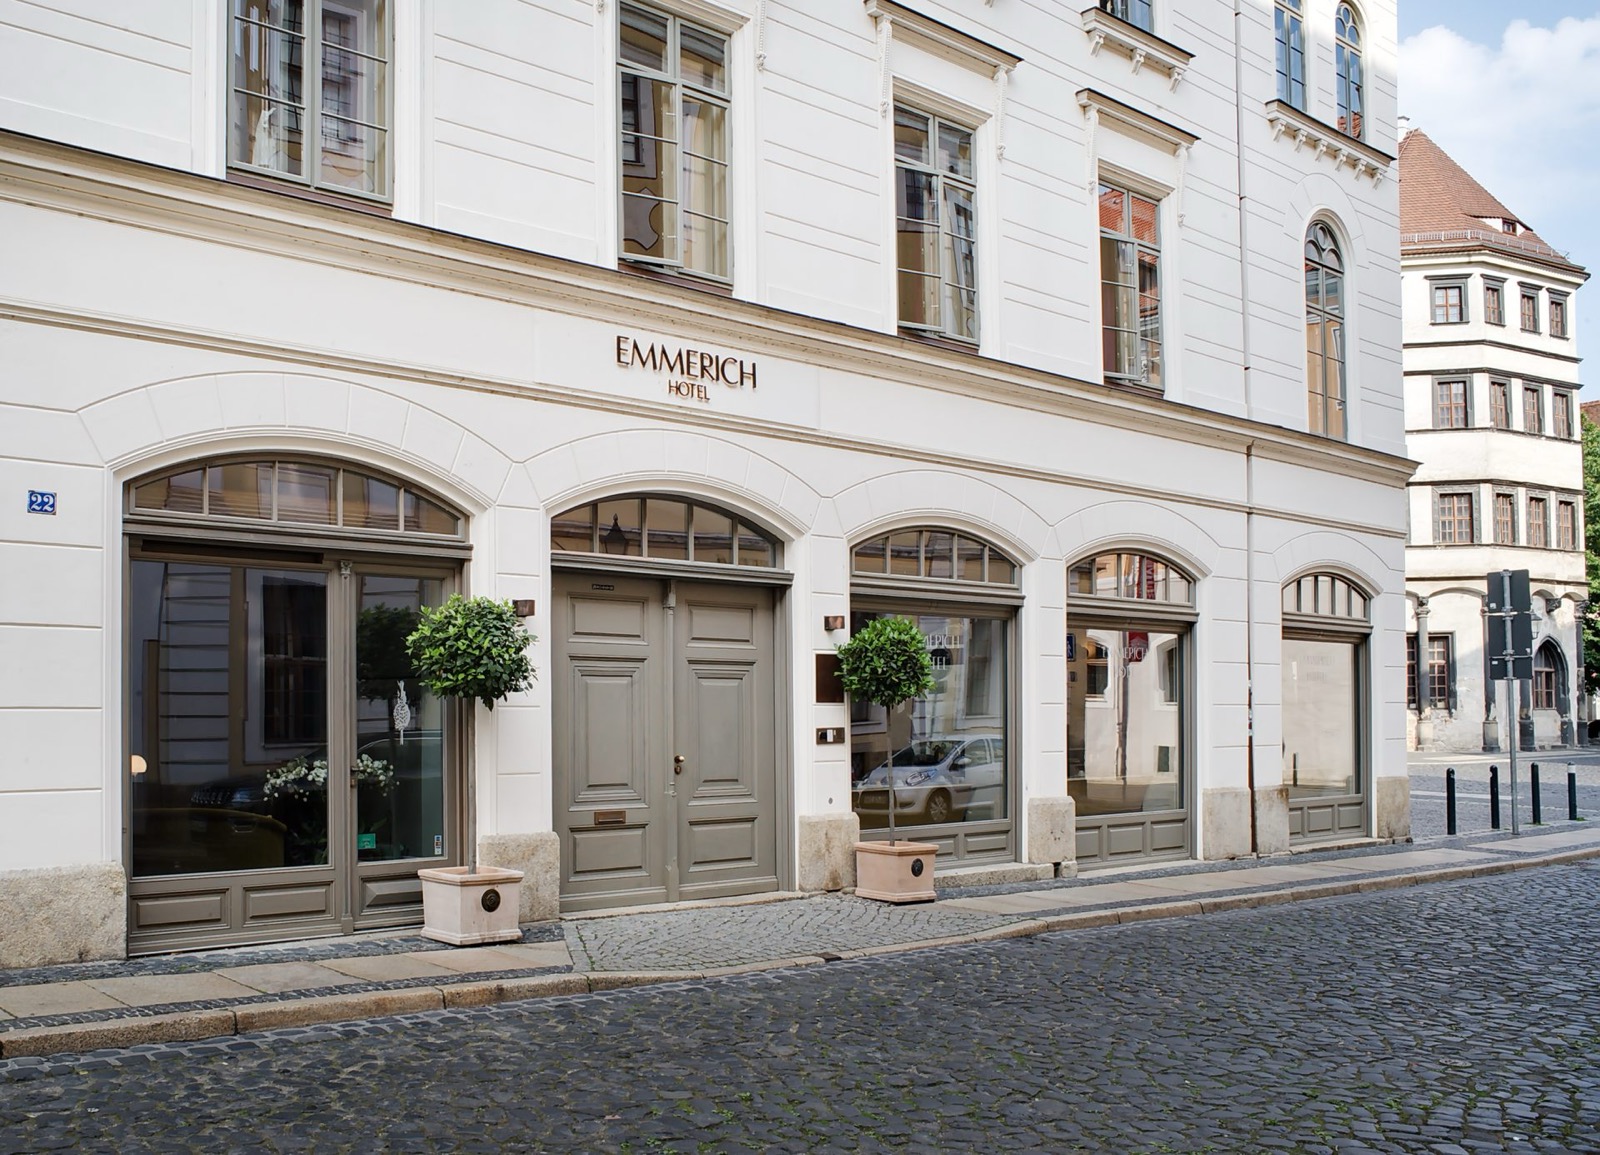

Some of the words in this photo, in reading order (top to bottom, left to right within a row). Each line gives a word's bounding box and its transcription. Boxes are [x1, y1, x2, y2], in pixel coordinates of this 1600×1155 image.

[616, 335, 757, 389] EMMERICH
[668, 380, 711, 401] HOTEL
[30, 494, 54, 511] 22
